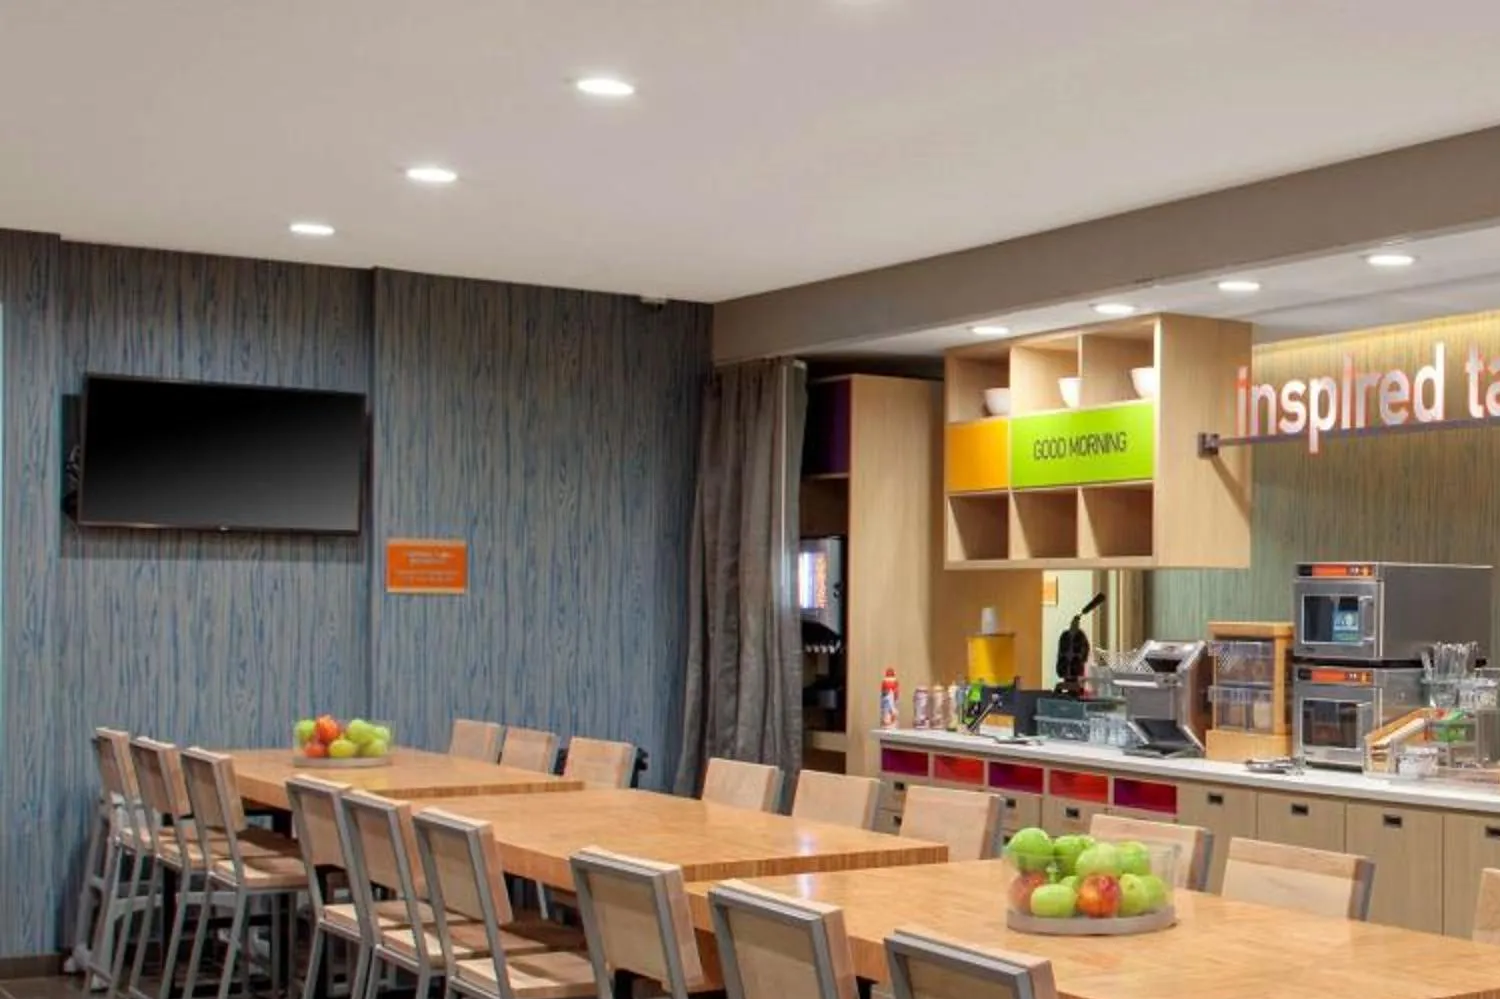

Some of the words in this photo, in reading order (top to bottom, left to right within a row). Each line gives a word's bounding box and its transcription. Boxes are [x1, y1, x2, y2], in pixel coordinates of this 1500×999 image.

[1234, 341, 1447, 455] inspired
[1033, 437, 1067, 461] GOOD
[1069, 431, 1128, 457] MORNING
